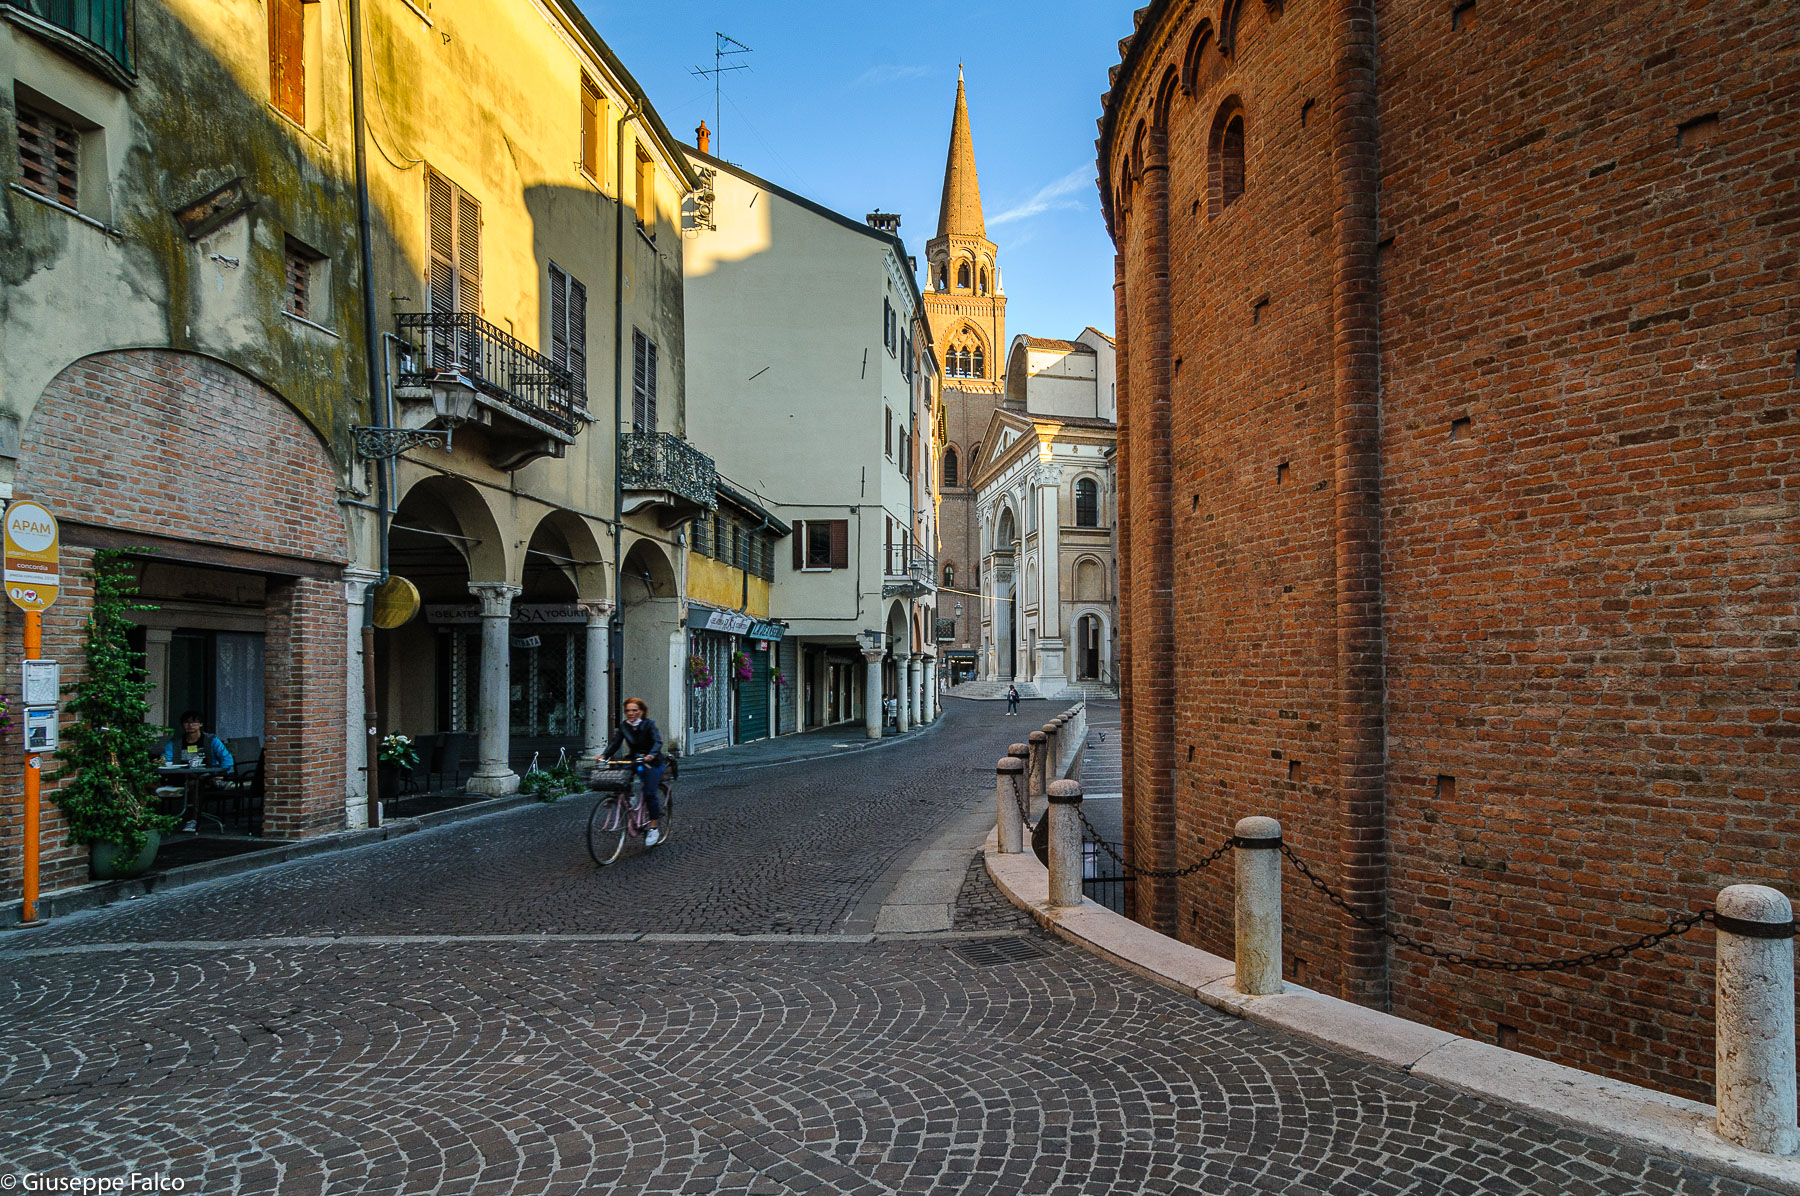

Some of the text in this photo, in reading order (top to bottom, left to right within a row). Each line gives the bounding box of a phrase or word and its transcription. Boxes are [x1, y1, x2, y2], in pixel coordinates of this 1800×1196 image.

[12, 519, 51, 535] APAM
[17, 563, 48, 571] concordia
[435, 610, 482, 618] GELATER
